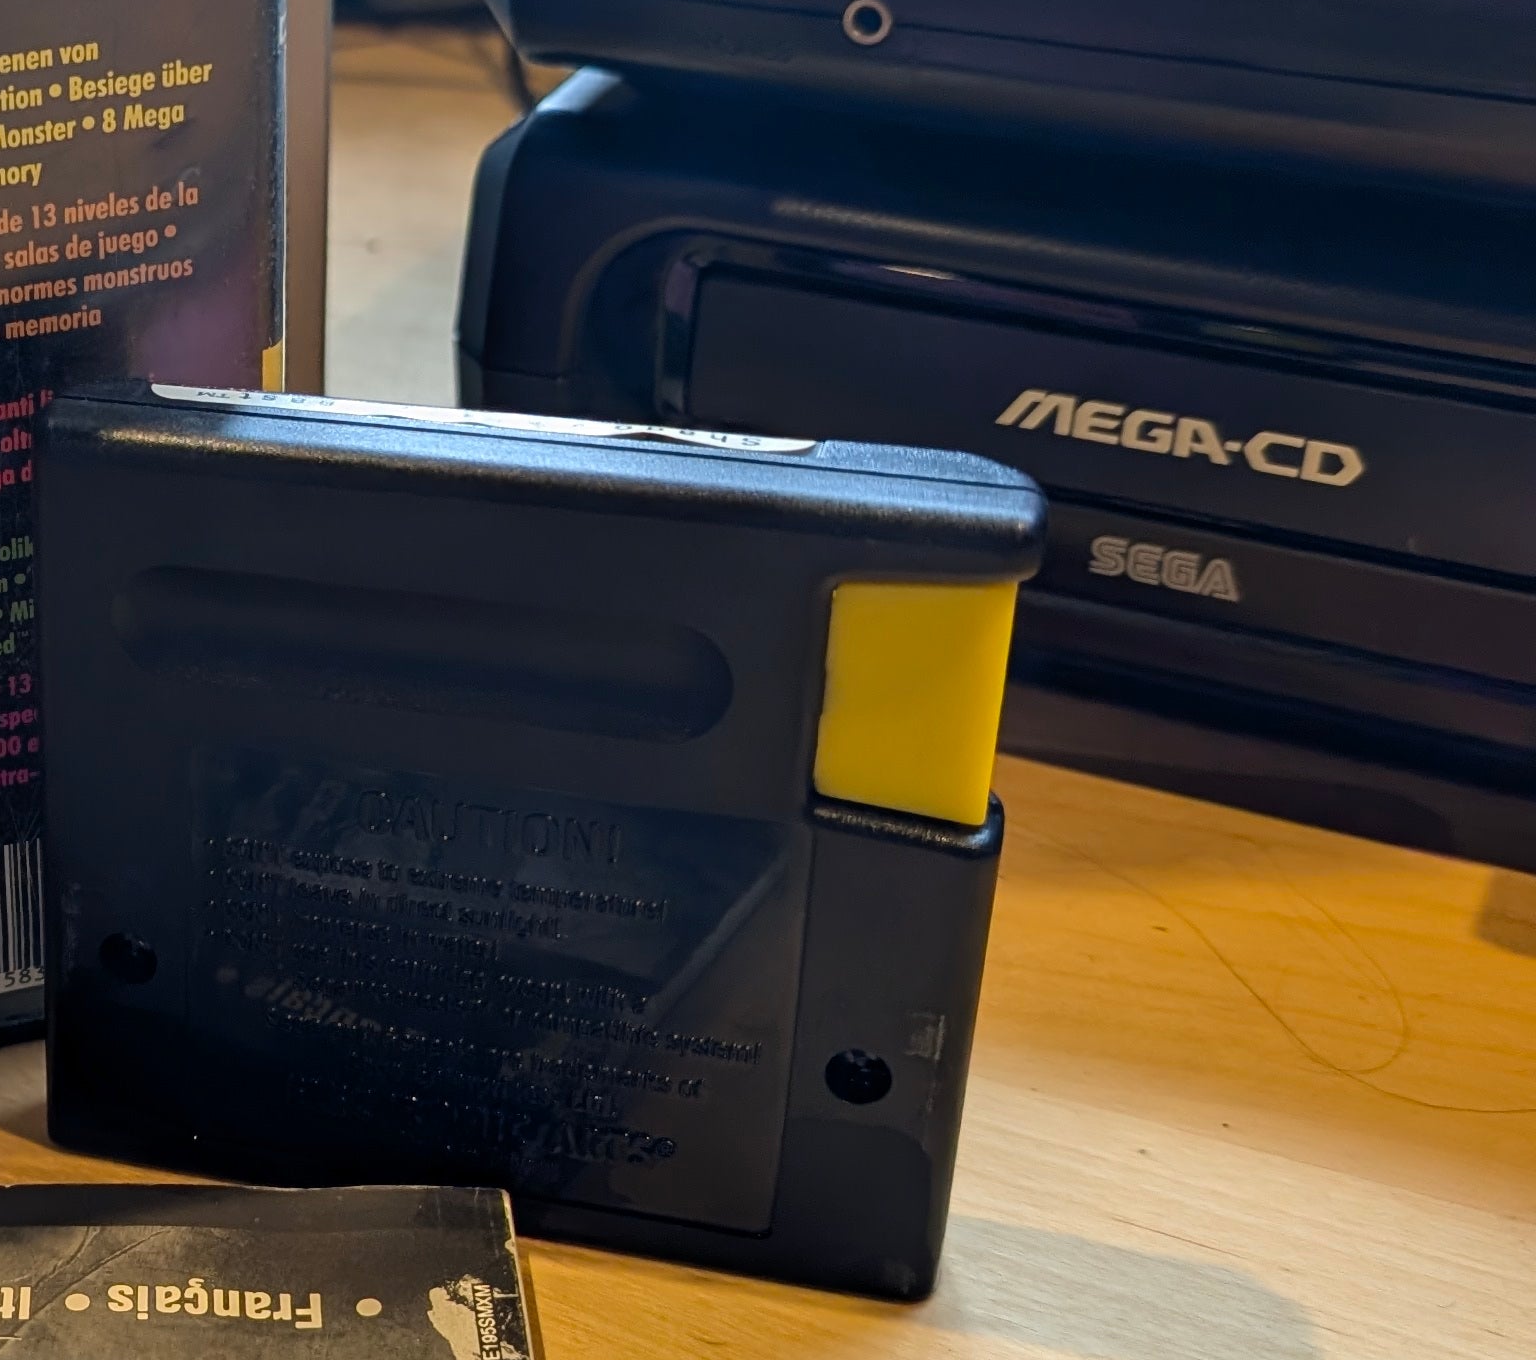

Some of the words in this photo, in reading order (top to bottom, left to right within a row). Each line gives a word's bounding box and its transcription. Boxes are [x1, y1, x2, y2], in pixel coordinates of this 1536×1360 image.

[59, 42, 98, 64] von
[69, 71, 155, 101] Besiege
[162, 60, 212, 87] über
[102, 108, 116, 132] 8
[123, 104, 184, 130] Mega
[32, 203, 56, 228] 13
[64, 192, 139, 224] niveles
[145, 186, 172, 211] de
[178, 181, 198, 206] la
[4, 240, 59, 269] salas
[65, 234, 92, 259] de
[98, 229, 158, 259] juego
[84, 259, 192, 291] monstruos
[994, 389, 1364, 487] MEGA-CD
[1088, 535, 1242, 602] SEGA
[8, 673, 31, 695] 13
[108, 1277, 322, 1329] Français
